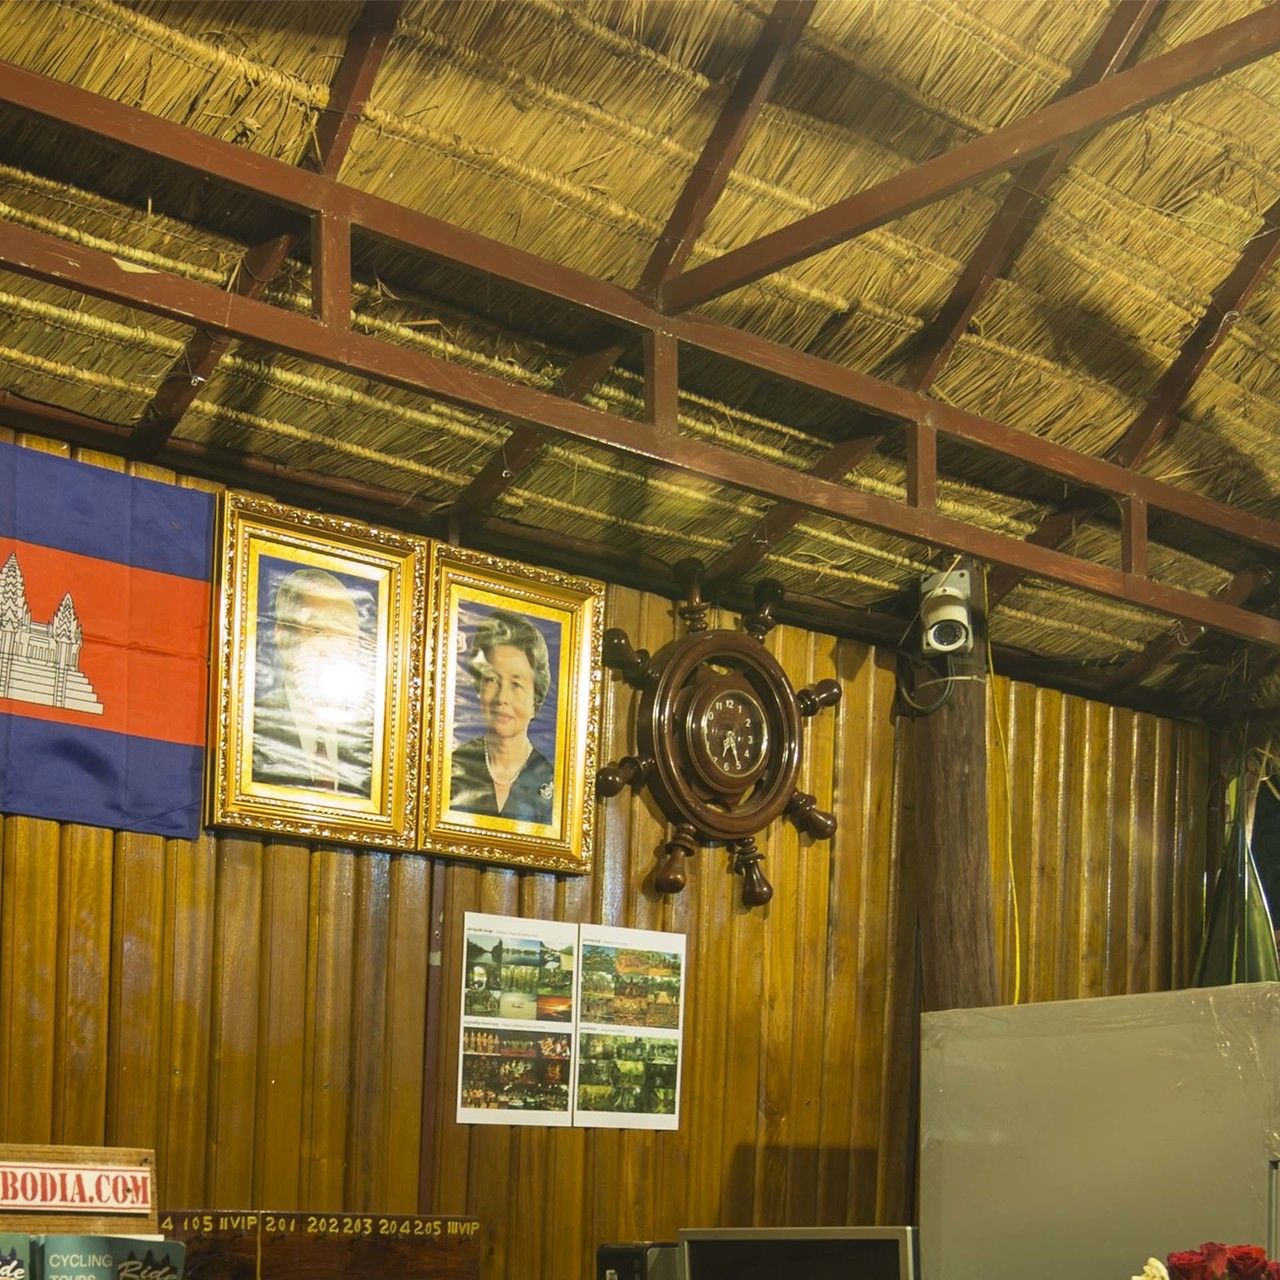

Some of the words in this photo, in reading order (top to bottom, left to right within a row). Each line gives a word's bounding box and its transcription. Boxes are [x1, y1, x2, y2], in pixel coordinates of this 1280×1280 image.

[715, 702, 723, 710] 11
[726, 700, 734, 709] 12
[745, 718, 751, 728] 2
[748, 735, 753, 745] 3
[744, 749, 750, 758] 4
[723, 762, 730, 771] 6
[183, 1216, 213, 1232] 105
[265, 1216, 295, 1232] 201
[306, 1216, 339, 1233] 202
[343, 1217, 373, 1234] 203
[379, 1218, 411, 1234] 204
[413, 1220, 441, 1236] 205
[49, 1254, 113, 1268] CYCLING
